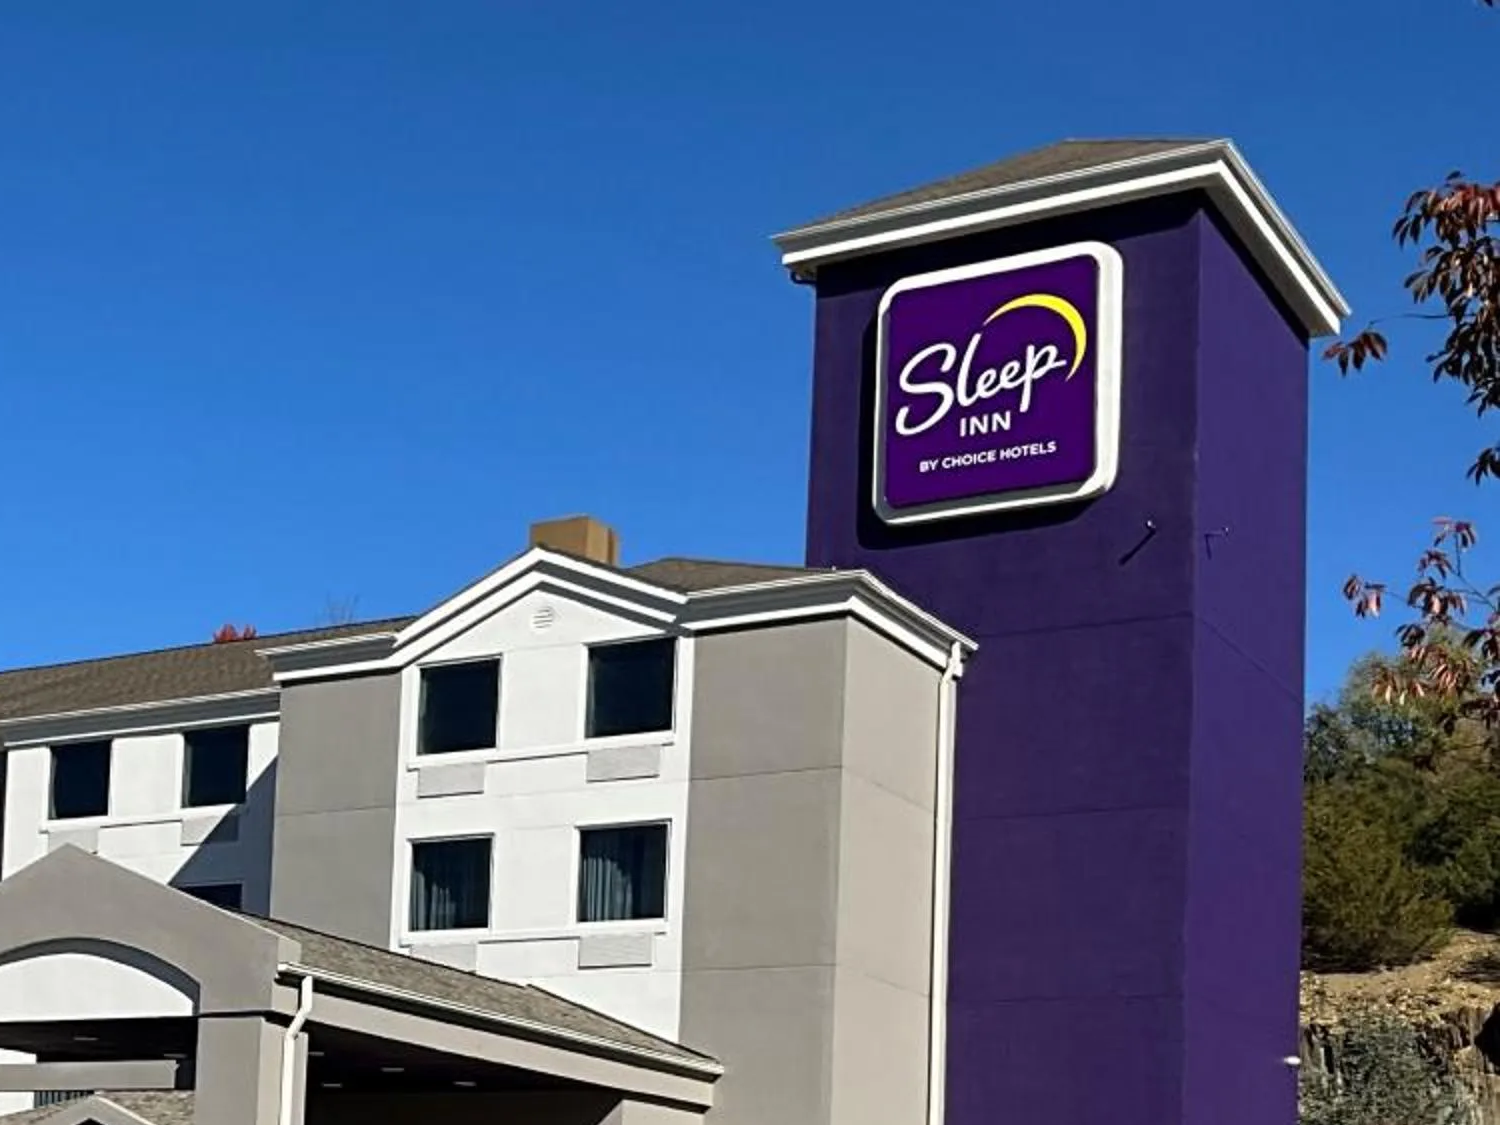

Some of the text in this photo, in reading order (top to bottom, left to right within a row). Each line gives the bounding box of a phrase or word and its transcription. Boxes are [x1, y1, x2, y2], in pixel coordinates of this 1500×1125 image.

[895, 332, 1067, 435] Sleep
[959, 410, 1011, 437] INN
[919, 441, 1057, 472] BY CHOICE HOTELS
